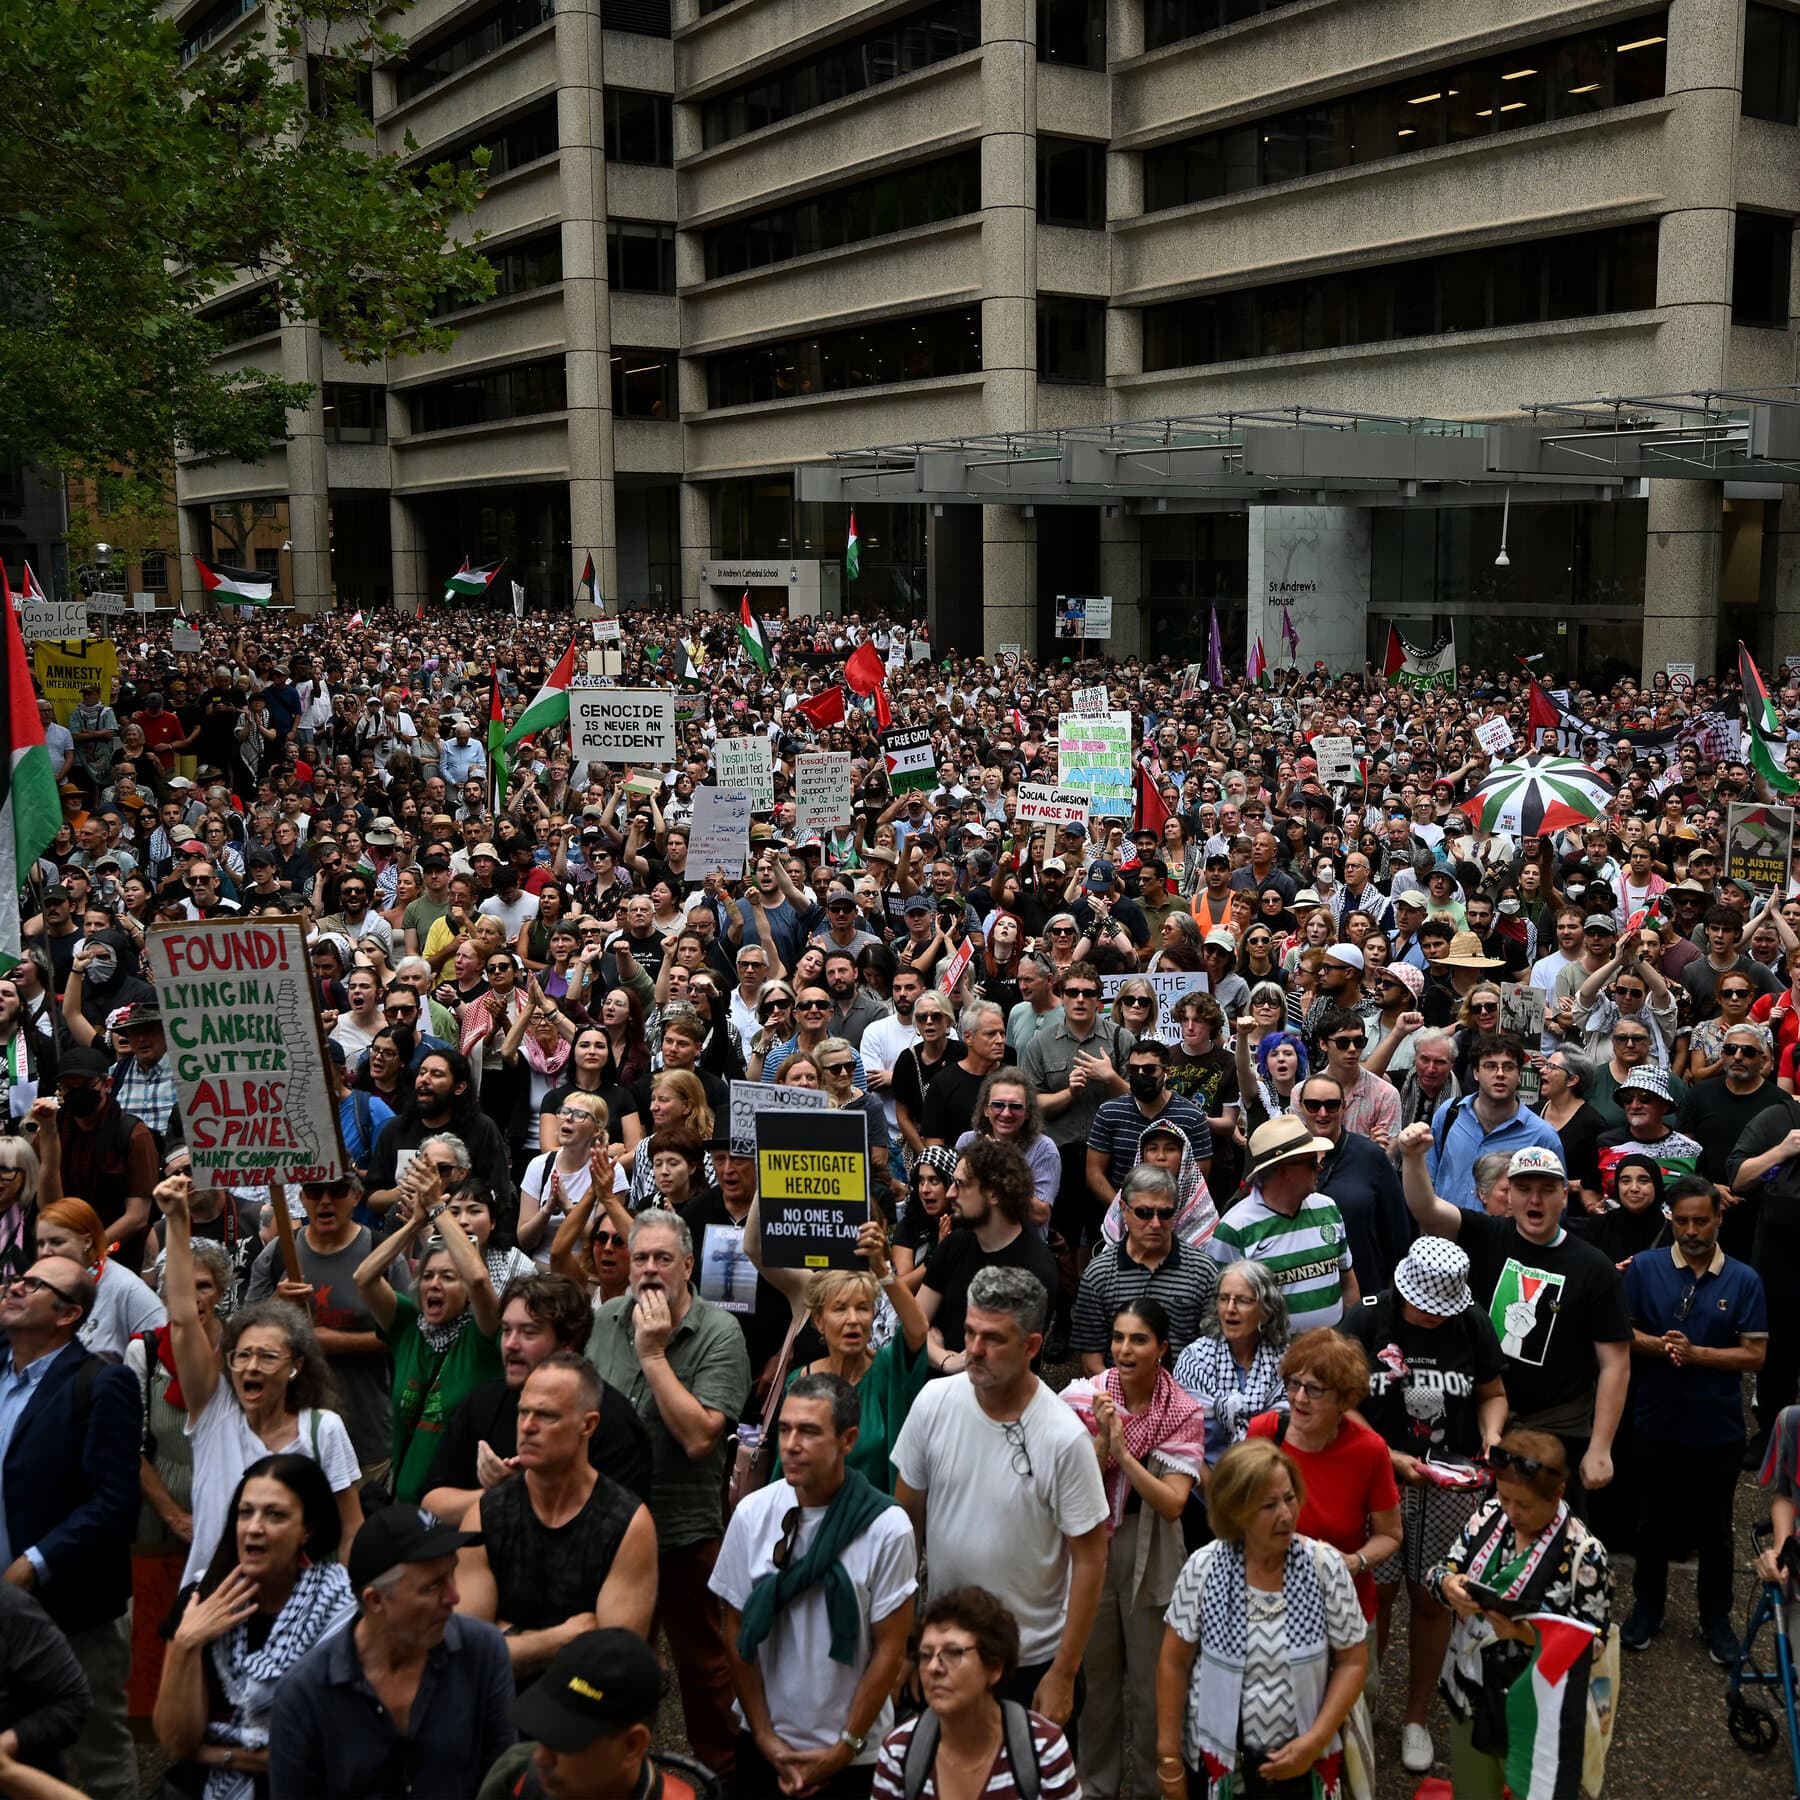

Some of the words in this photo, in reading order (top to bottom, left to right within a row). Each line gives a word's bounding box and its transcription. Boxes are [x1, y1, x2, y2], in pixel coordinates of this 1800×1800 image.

[717, 569, 723, 577] St
[723, 568, 742, 577] Andrew's
[743, 568, 762, 578] Cathedral
[763, 568, 779, 578] School
[1268, 581, 1278, 592] St
[1280, 580, 1317, 592] Andrew's
[1268, 596, 1295, 606] House
[24, 606, 42, 622] Go
[45, 612, 54, 622] to
[24, 623, 84, 639] Genocider
[46, 666, 102, 680] AMNESTY
[580, 704, 664, 718] GENOCIDE
[586, 721, 598, 730] IS
[604, 720, 640, 732] NEVER
[646, 721, 661, 732] AN
[582, 734, 666, 748] ACCIDENT
[886, 732, 910, 748] FREE
[910, 729, 931, 743] GAZA
[722, 752, 762, 764] hospitals
[904, 752, 927, 765] FREE
[723, 762, 763, 776] unlimited
[802, 766, 826, 775] arrest
[831, 764, 843, 776] ppl
[801, 776, 836, 786] marching
[802, 786, 830, 796] support
[835, 784, 844, 792] of
[1019, 786, 1048, 802] SOCIAL
[1050, 790, 1089, 806] COHESION
[798, 796, 806, 805] UN
[810, 804, 839, 816] against
[1022, 804, 1038, 816] MY
[1038, 806, 1062, 818] ARSE
[1065, 808, 1083, 821] JIM
[806, 816, 840, 826] genocide
[1732, 856, 1744, 866] NO
[1746, 858, 1784, 870] JUSTICE
[1730, 868, 1746, 878] NO
[1748, 870, 1784, 883] PEACE
[162, 928, 290, 976] FOUND!
[1152, 977, 1186, 991] THE
[163, 982, 234, 1009] LYING
[240, 980, 260, 1004] IN
[264, 982, 274, 1004] A
[170, 1014, 284, 1050] CANBERRA
[178, 1049, 288, 1082] GUTTER
[187, 1080, 286, 1117] ALBO'S
[193, 1117, 299, 1149] SPINE!
[192, 1150, 234, 1168] MINT
[236, 1150, 313, 1168] CONDITION
[768, 1154, 856, 1174] INVESTIGATE
[212, 1166, 276, 1187] NEVER
[284, 1161, 336, 1183] USED!
[786, 1177, 840, 1195] HERZOG
[783, 1208, 802, 1222] NO
[804, 1208, 830, 1222] ONE
[832, 1210, 844, 1224] IS
[766, 1222, 807, 1236] ABOVE
[810, 1224, 834, 1238] THE
[836, 1226, 860, 1239] LAW
[1508, 1260, 1524, 1272] Free
[1503, 1516, 1562, 1600] PALESTIN
